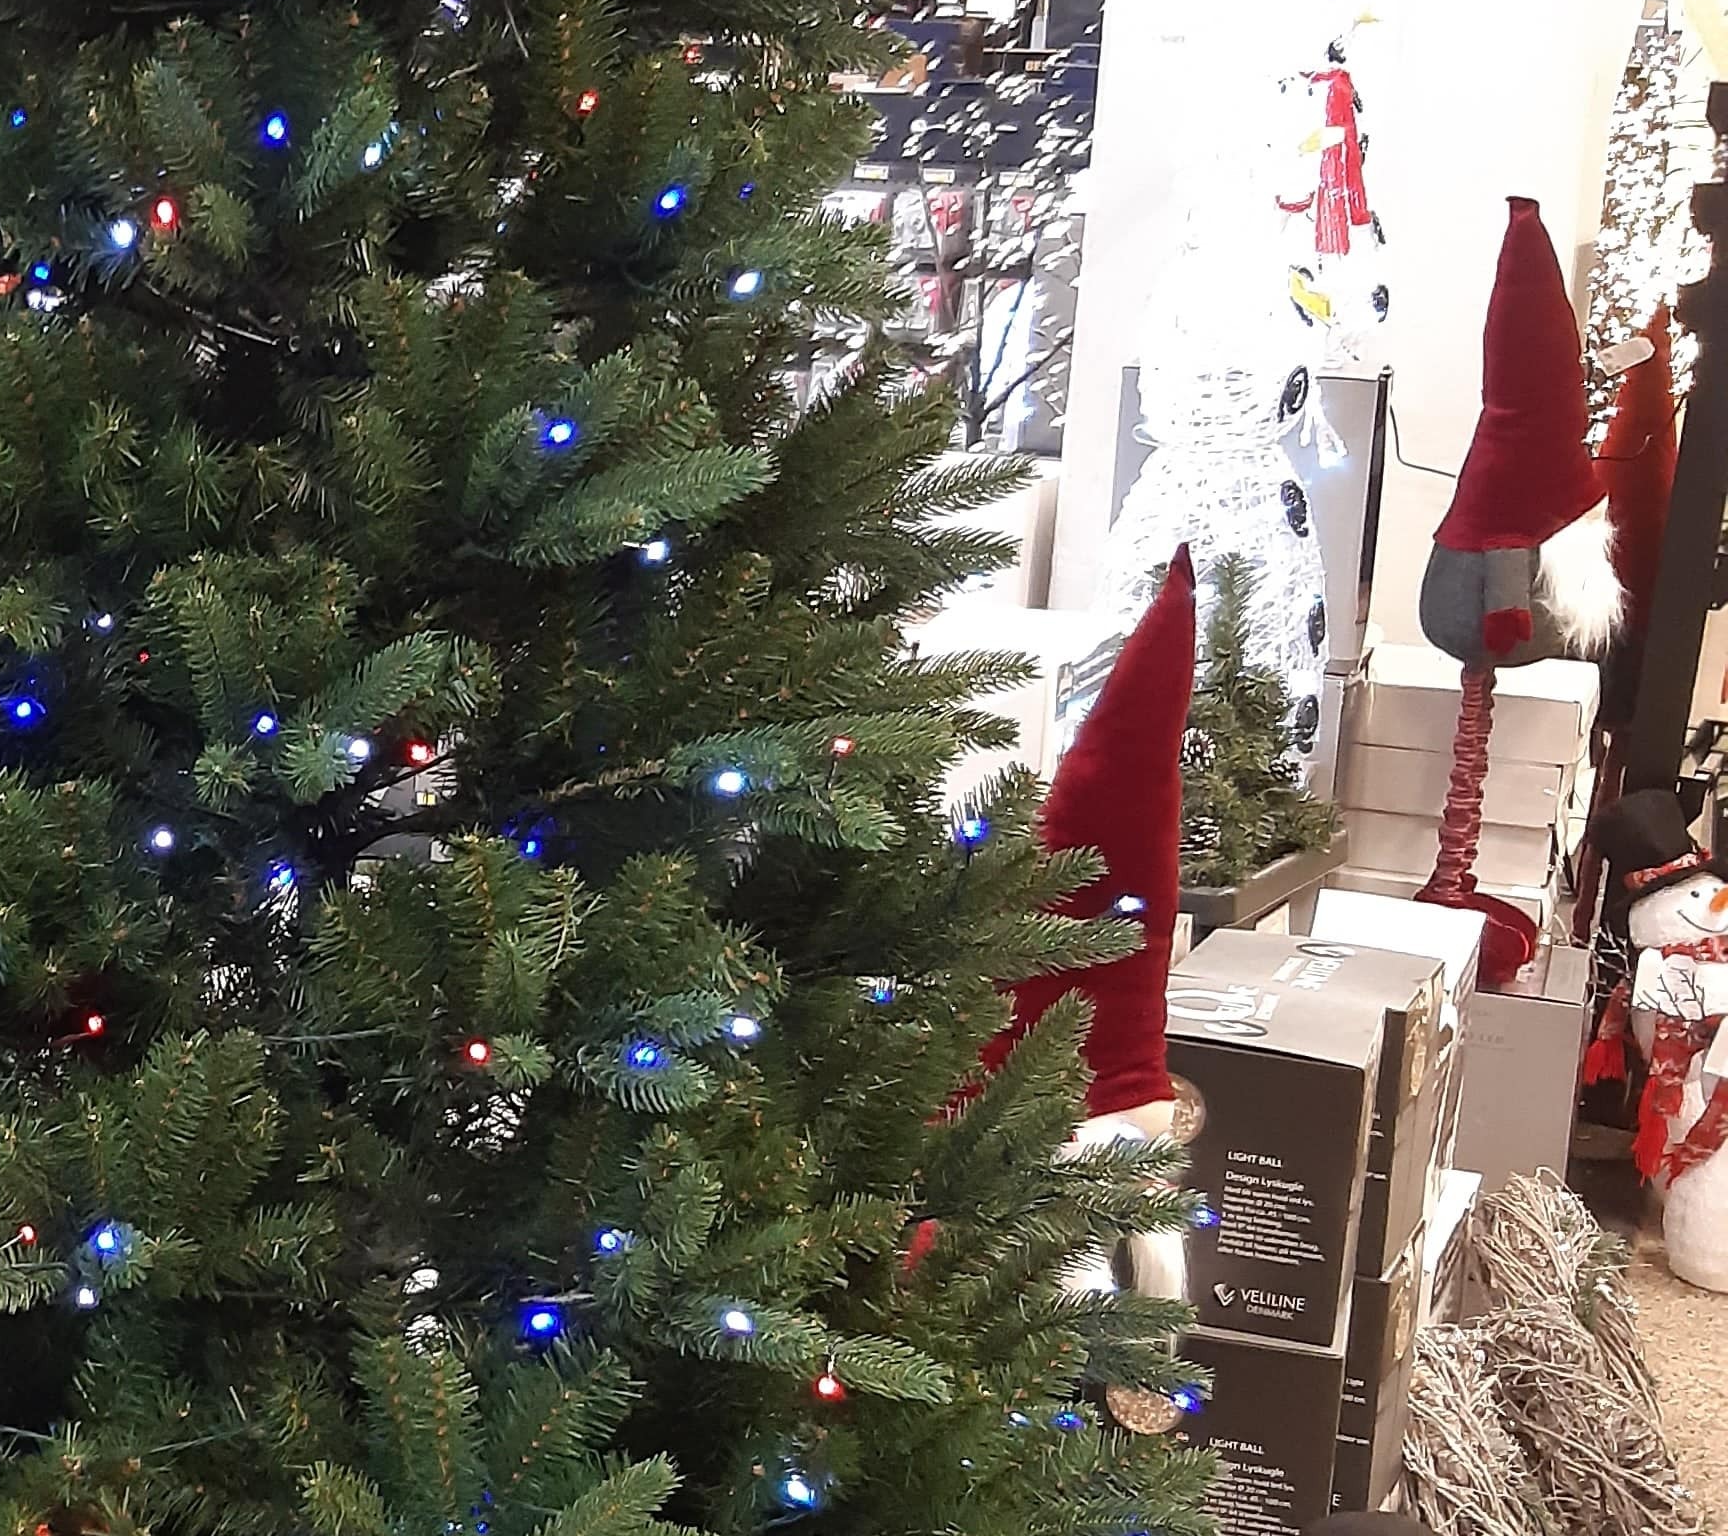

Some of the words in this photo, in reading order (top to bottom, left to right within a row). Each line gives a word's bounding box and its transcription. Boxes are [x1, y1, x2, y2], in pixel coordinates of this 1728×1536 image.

[1228, 1150, 1257, 1164] LIGHT
[1259, 1156, 1282, 1168] BALL
[1240, 1287, 1306, 1312] VELILINE
[1209, 1437, 1238, 1450] LIGHT
[1240, 1442, 1265, 1455] BALL
